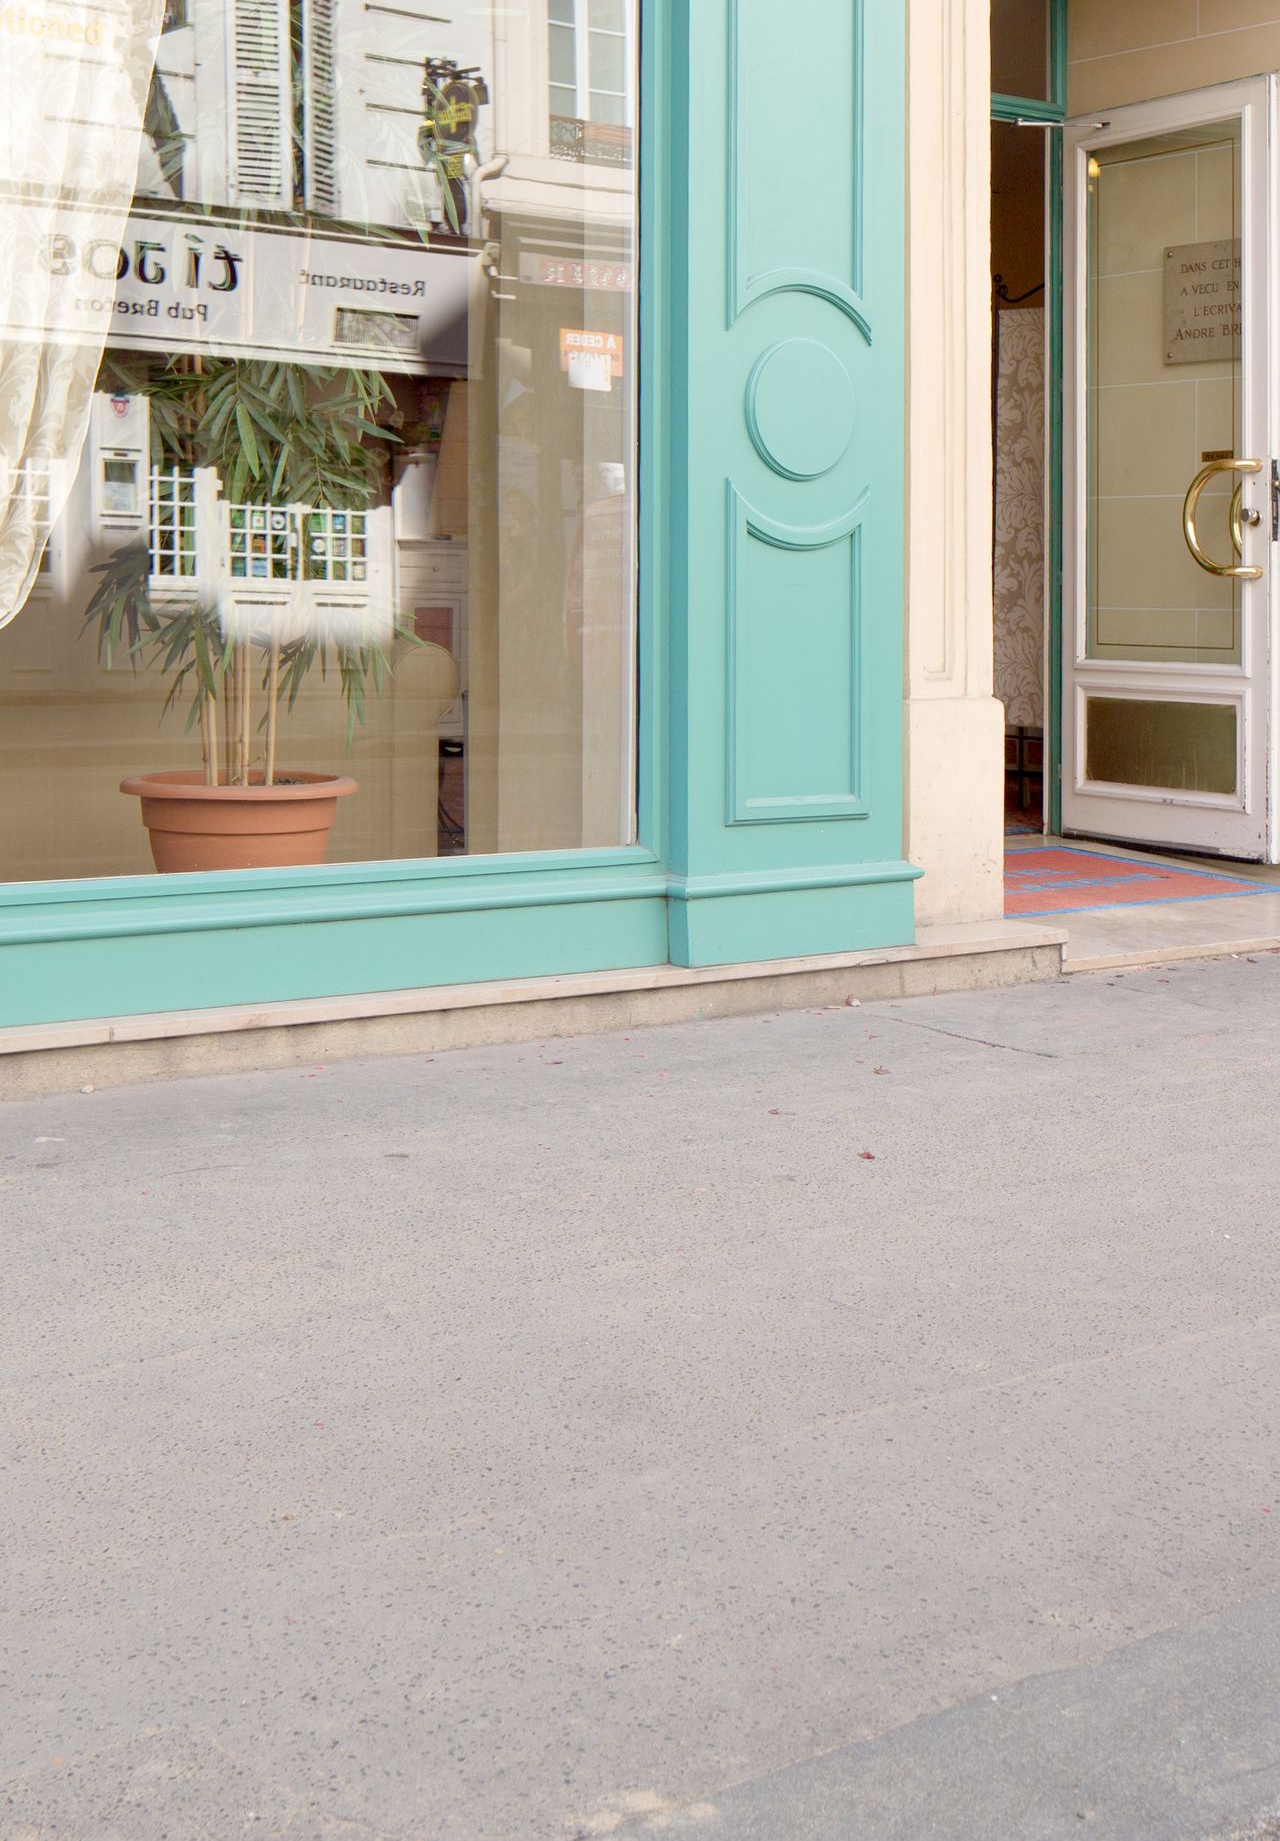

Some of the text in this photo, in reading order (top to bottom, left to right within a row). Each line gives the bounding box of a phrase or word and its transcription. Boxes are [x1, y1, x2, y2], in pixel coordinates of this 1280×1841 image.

[1181, 261, 1207, 274] DANS
[1212, 259, 1231, 270] CET
[1192, 283, 1219, 295] VECU
